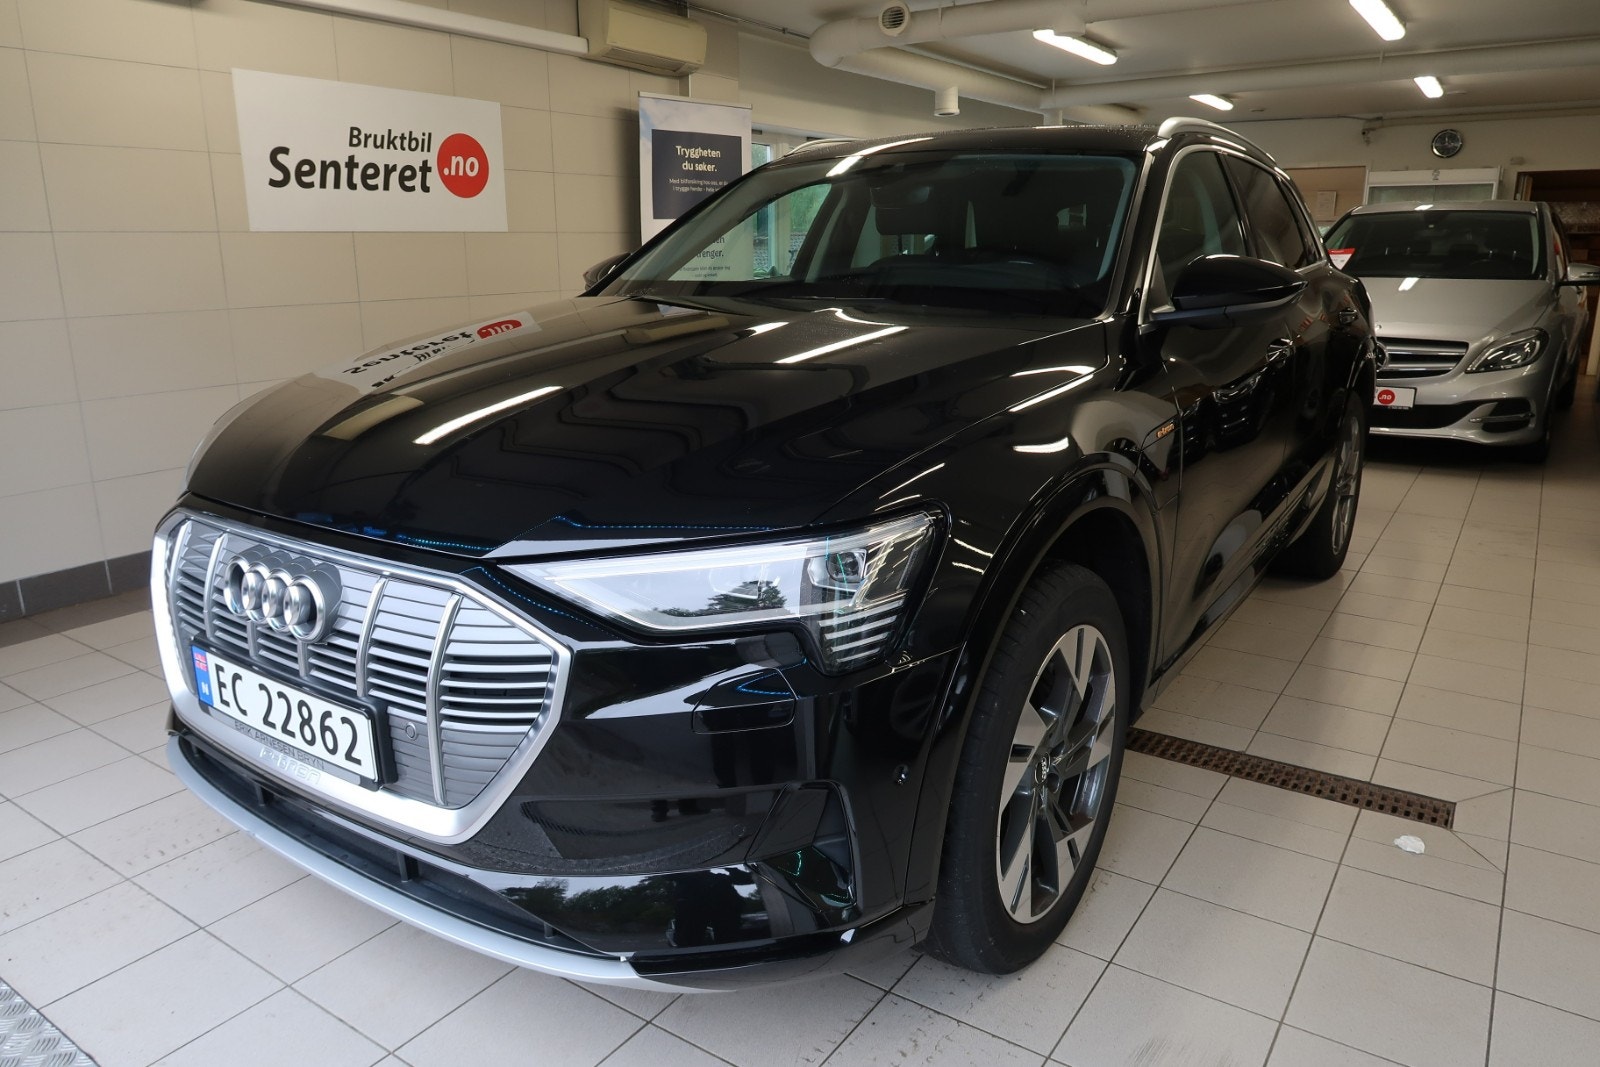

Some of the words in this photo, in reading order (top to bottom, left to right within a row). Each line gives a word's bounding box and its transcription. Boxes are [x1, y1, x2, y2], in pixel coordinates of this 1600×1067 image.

[348, 126, 432, 153] Bruktbil
[675, 145, 721, 158] Tryggheten
[268, 145, 432, 193] Senteret
[443, 155, 480, 177] .no
[682, 160, 694, 171] du
[695, 162, 718, 172] søker.
[214, 663, 248, 717] EC
[258, 683, 362, 766] 22862
